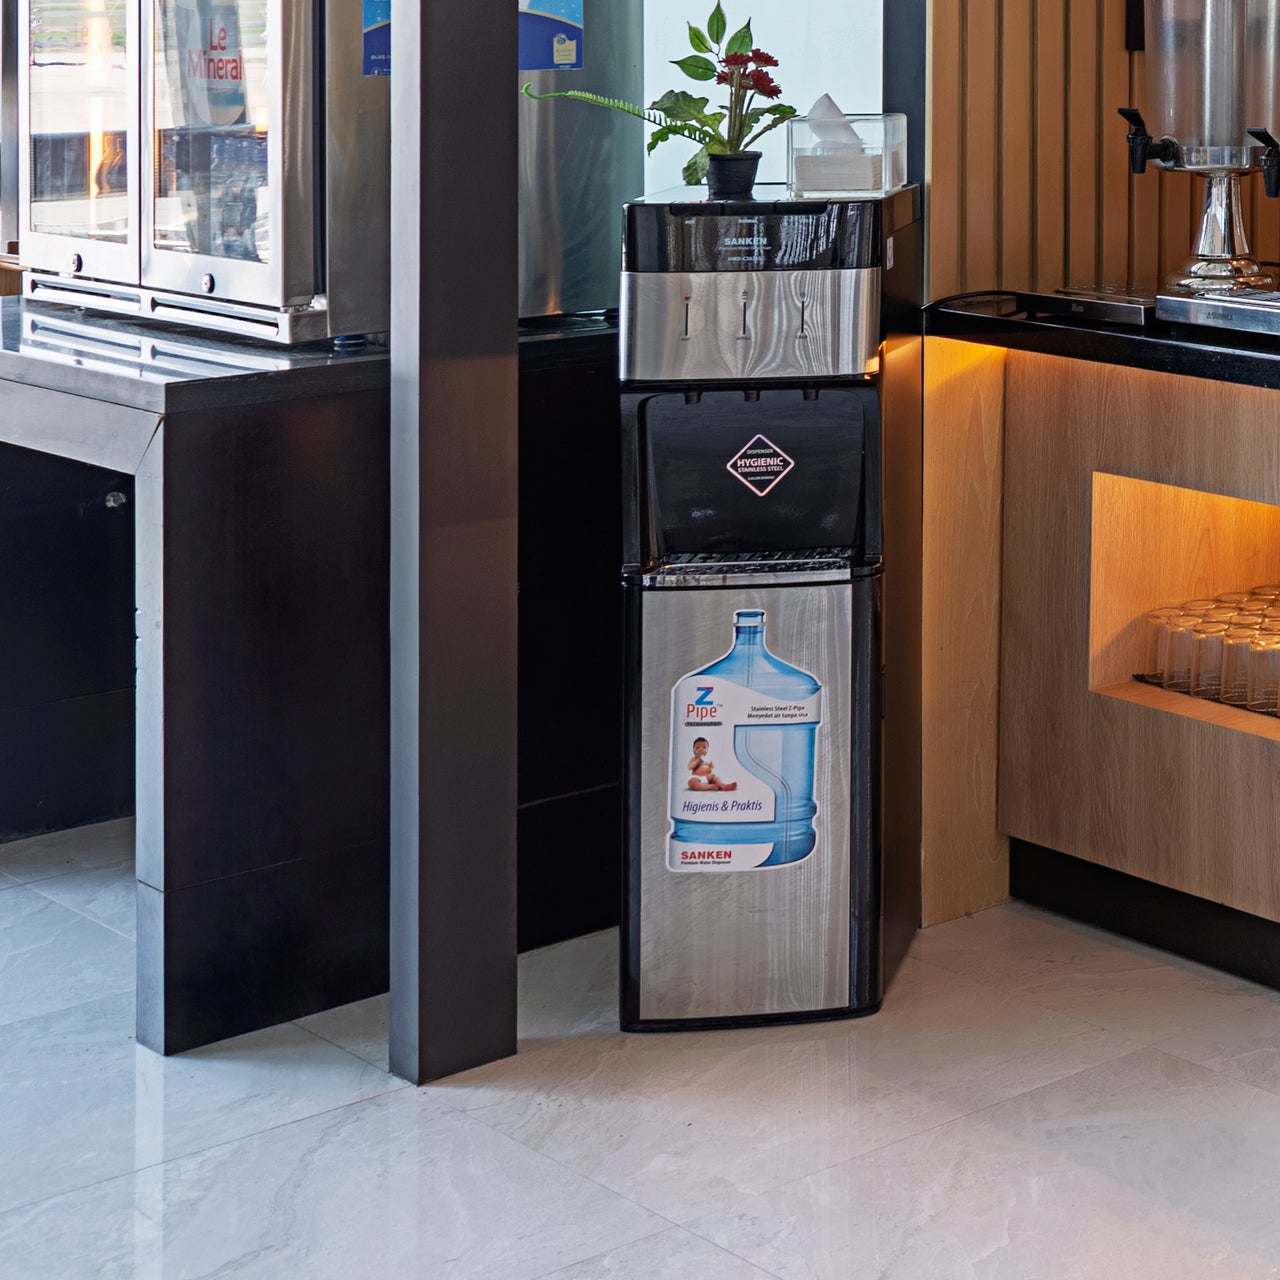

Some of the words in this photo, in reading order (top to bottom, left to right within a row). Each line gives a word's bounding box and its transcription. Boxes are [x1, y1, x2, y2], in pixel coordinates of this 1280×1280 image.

[209, 18, 227, 50] Le
[724, 238, 768, 246] SANKEN
[737, 457, 784, 467] HYGIENIC
[695, 686, 714, 706] Z
[686, 704, 718, 721] Pipe
[682, 802, 719, 816] Higienis
[721, 802, 729, 812] &
[730, 800, 762, 811] Praktis
[681, 851, 732, 860] SANKEN
